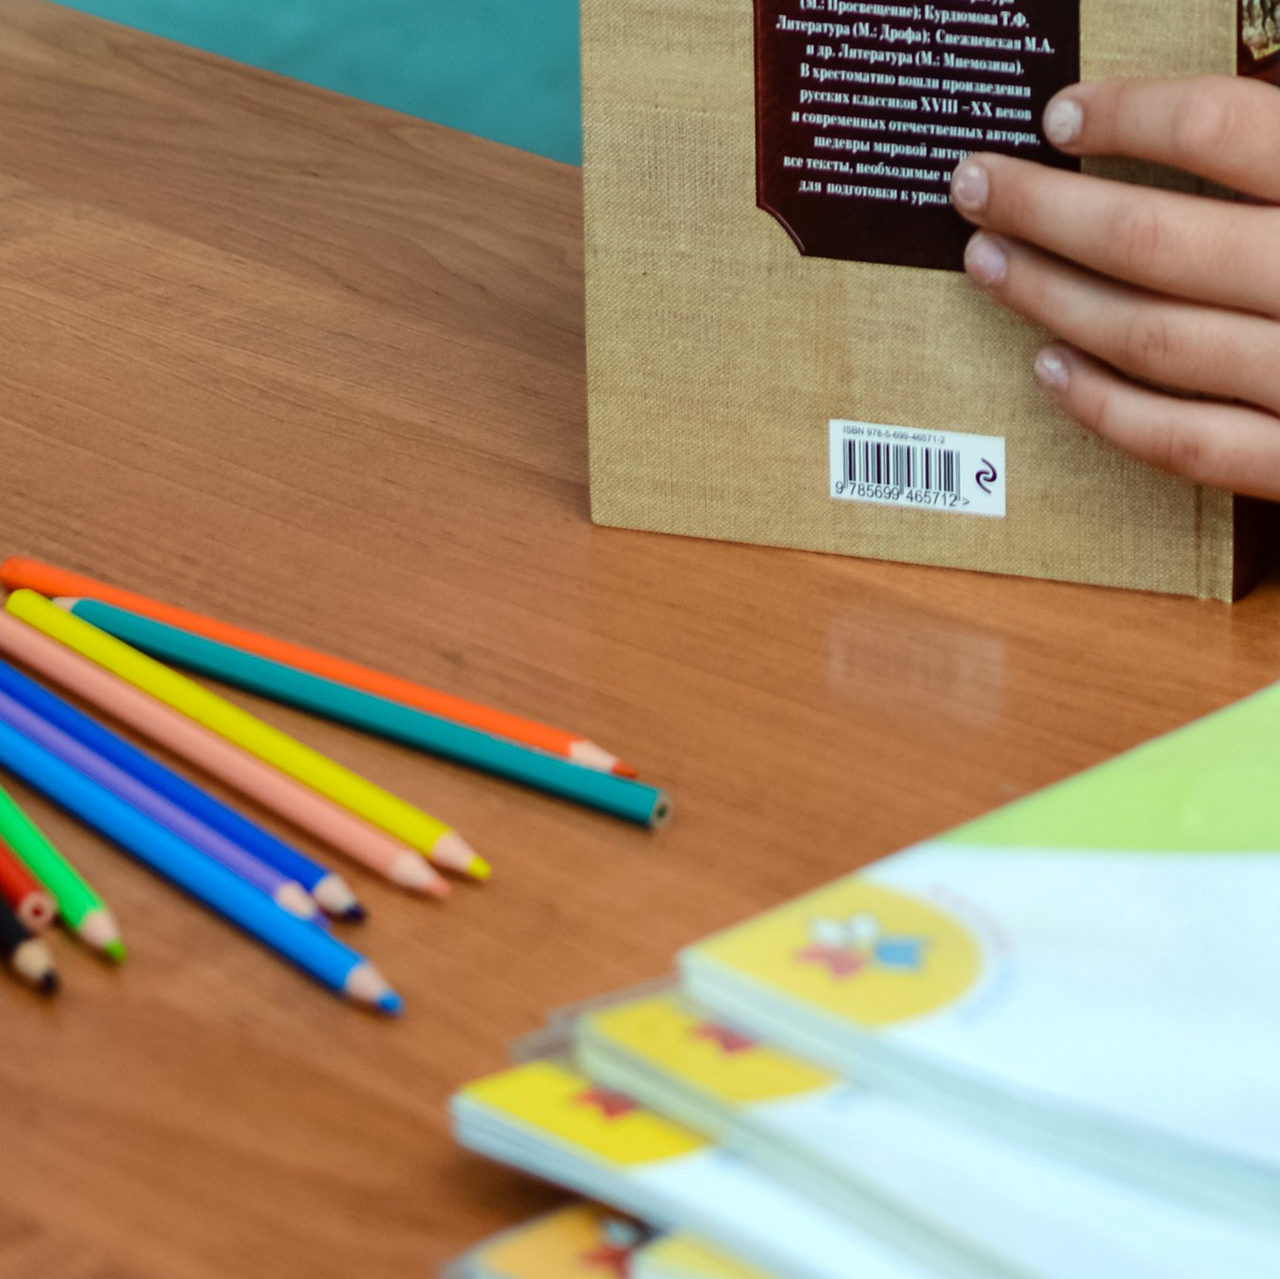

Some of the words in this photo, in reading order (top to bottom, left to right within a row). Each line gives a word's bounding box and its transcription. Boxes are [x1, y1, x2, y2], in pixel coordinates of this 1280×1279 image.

[924, 4, 998, 26] Курдюмова
[1000, 10, 1030, 28] Т.Ф.
[775, 14, 850, 38] Литература
[852, 21, 877, 37] (М.:
[879, 23, 931, 45] Дрофа);
[935, 28, 1022, 51] Снежневская
[1024, 36, 1055, 53] М.А.
[806, 44, 814, 55] и
[816, 45, 836, 60] др.
[838, 43, 913, 67] Литература
[914, 50, 940, 66] (М.:
[943, 52, 1024, 75] Мнемозина).
[800, 62, 810, 78] В
[812, 67, 896, 85] хрестоматию
[897, 75, 940, 89] вошли
[942, 79, 1031, 97] произведения
[799, 89, 850, 104] русских
[852, 94, 918, 110] классиков
[920, 96, 958, 114] XVIII
[995, 107, 1032, 121] веков
[791, 111, 800, 122] и
[801, 112, 886, 130] современных
[888, 120, 983, 139] отечественных
[813, 136, 870, 154] шедевры
[873, 141, 927, 158] мировой
[783, 155, 804, 168] все
[806, 157, 854, 174] тексты,
[856, 161, 940, 181] необходимые
[798, 180, 822, 192] для
[826, 182, 898, 200] подготовки
[900, 190, 909, 201] к
[911, 190, 953, 205] урока
[843, 425, 864, 436] ISBN
[866, 427, 945, 444] 978-5-699-46571-2
[835, 481, 844, 494] 9
[849, 482, 900, 500] 785699
[906, 491, 957, 507] 465712
